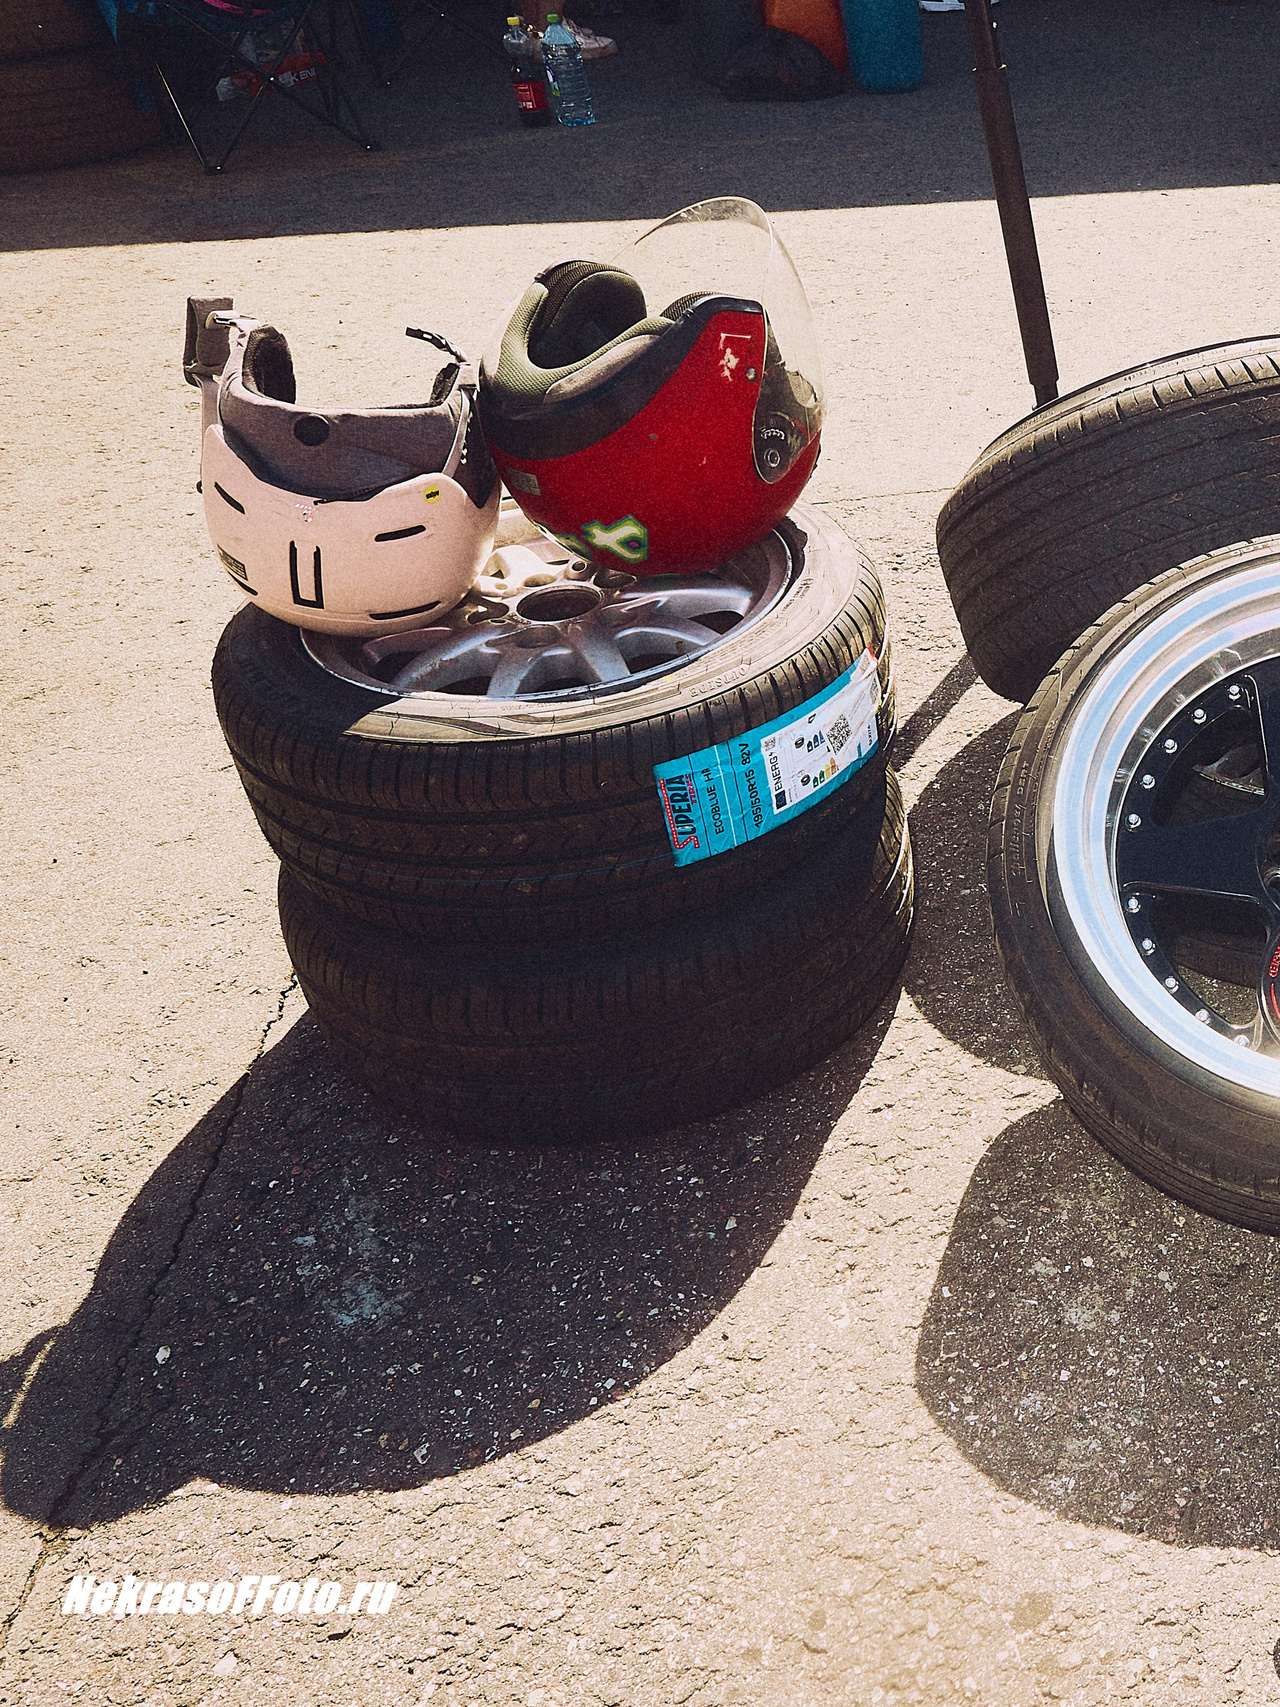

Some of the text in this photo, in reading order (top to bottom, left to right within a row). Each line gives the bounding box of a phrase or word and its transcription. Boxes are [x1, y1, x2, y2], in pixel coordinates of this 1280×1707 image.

[690, 667, 746, 698] OUTSIDE
[658, 774, 700, 849] SUPERIA
[707, 784, 725, 834] ECOBLUE
[738, 743, 763, 828] 195/50R15 82V
